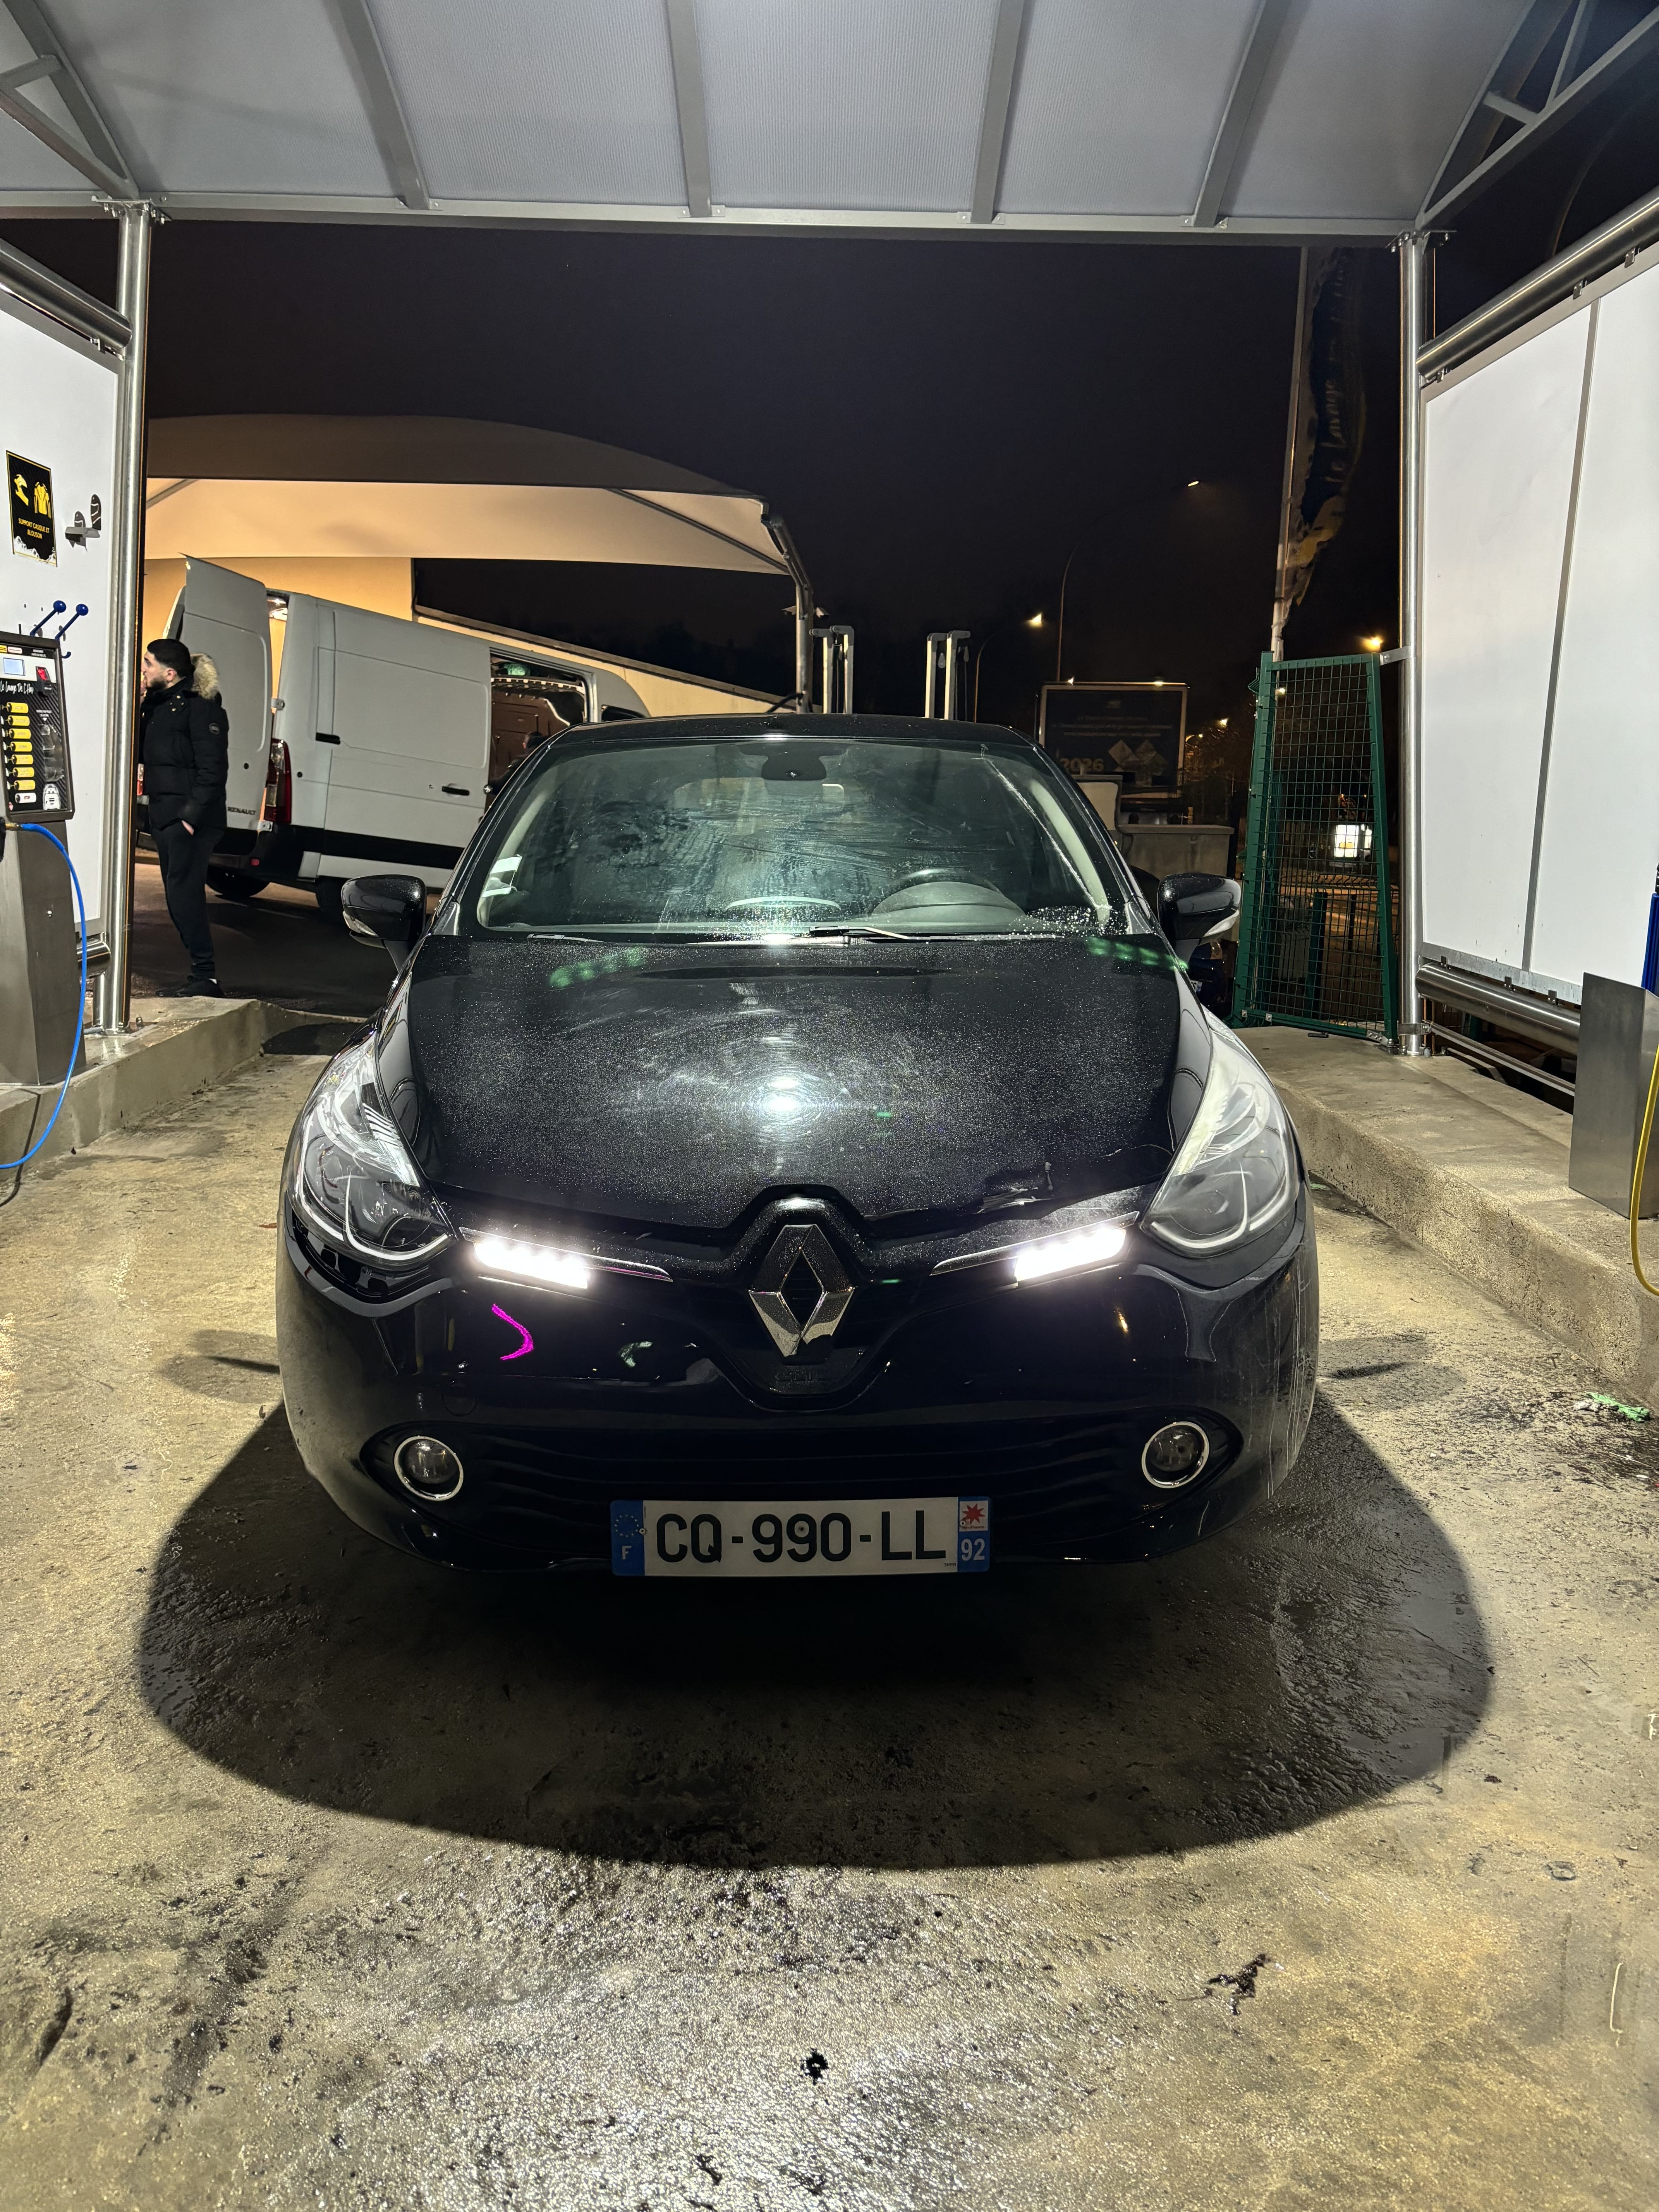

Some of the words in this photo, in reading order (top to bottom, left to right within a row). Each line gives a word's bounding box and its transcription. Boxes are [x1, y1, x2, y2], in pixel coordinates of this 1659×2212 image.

[18, 518, 33, 527] SUPPORT
[33, 523, 46, 532] CASQUE
[27, 529, 43, 539] BLOUSON
[1060, 758, 1104, 771] 2026
[228, 807, 256, 815] RENAULT
[622, 1545, 632, 1560] F
[656, 1510, 946, 1563] CQ-990-LL
[961, 1538, 985, 1561] 92
